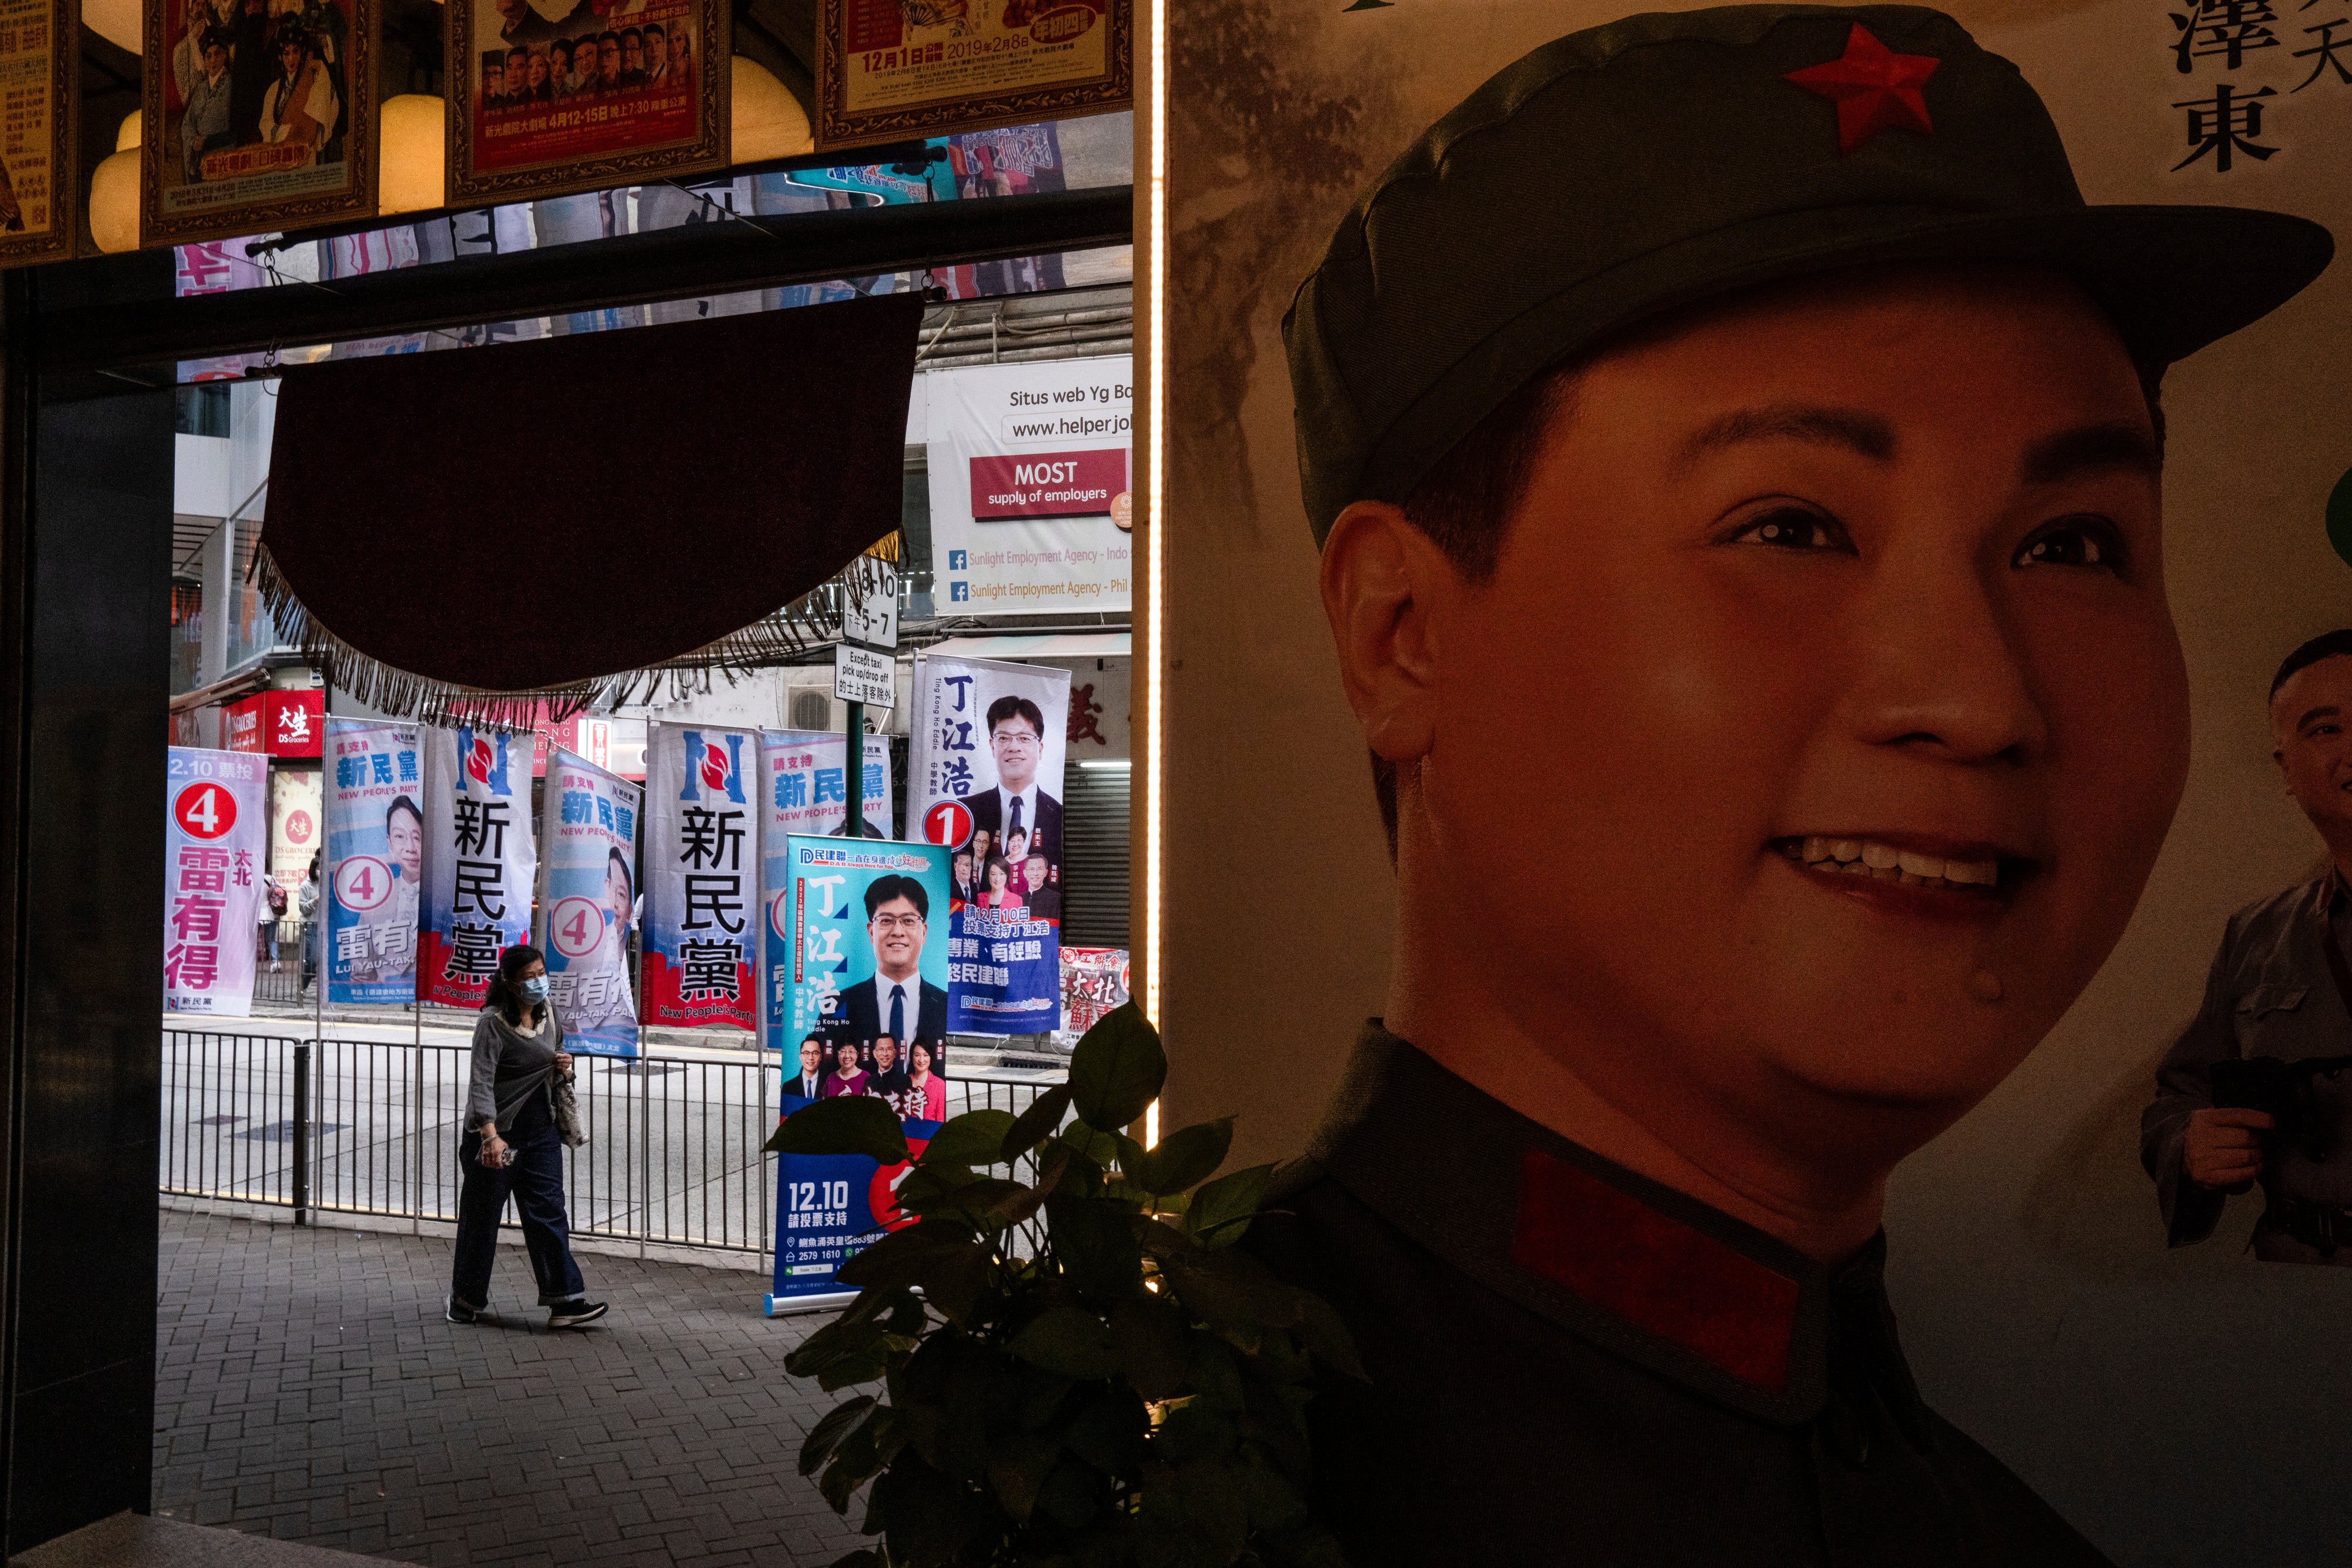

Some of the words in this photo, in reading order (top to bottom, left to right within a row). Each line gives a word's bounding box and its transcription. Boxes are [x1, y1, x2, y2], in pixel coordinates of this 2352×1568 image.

[947, 34, 1028, 59] 2019年2月8日
[862, 47, 923, 73] 12月1日
[2168, 0, 2281, 173] 澤東
[549, 105, 608, 129] 4月12-15日
[610, 99, 649, 118] 晚上7:30
[1009, 390, 1049, 407] Situs
[1053, 387, 1085, 403] web
[1090, 385, 1110, 403] Yg
[1012, 414, 1132, 437] www.helperjo
[1015, 461, 1078, 486] MOST
[988, 490, 1026, 506] supply
[1029, 489, 1041, 502] of
[1045, 487, 1107, 504] employers
[969, 551, 1004, 567] Sunlight
[1007, 549, 1062, 567] Employment
[1064, 547, 1097, 565] Agency
[1107, 547, 1128, 560] Indo
[971, 583, 1006, 600] Sunlight
[1009, 581, 1065, 599] Employment
[1067, 580, 1101, 597] Agency
[1111, 578, 1128, 593] Phil
[847, 613, 860, 631] 下午
[862, 608, 888, 635] 5-7
[850, 651, 870, 667] Except
[871, 657, 882, 669] taxi
[843, 664, 854, 677] pick
[856, 668, 878, 684] up/drop
[880, 673, 888, 684] off
[839, 679, 891, 702] 的士上落客除外
[279, 705, 310, 737] 大生
[934, 717, 940, 727] Ho
[279, 734, 288, 743] DS
[941, 675, 975, 796] 丁江浩
[337, 740, 368, 755] 請支持
[219, 762, 253, 780] 票投
[336, 749, 419, 790] 新民黨
[773, 754, 813, 771] 請支持
[563, 775, 594, 791] 請支持
[774, 763, 884, 810] 新民黨
[929, 762, 938, 795] 中學教師
[338, 791, 359, 801] NEW
[363, 788, 398, 797] PEOPLE'S
[400, 785, 418, 794] PARTY
[186, 789, 218, 832] 4
[561, 790, 634, 841] 新民黨
[776, 811, 801, 822] NEW
[804, 805, 847, 818] PEOPLE'S
[290, 818, 309, 837] 大生
[561, 827, 584, 837] NEW
[937, 807, 954, 845] 1
[815, 849, 847, 861] 民建聯
[232, 848, 253, 887] 太北
[349, 866, 375, 900] 4
[442, 796, 510, 985] 新民黨
[679, 805, 747, 1003] 新民黨
[964, 904, 1030, 923] 請12月10日
[165, 845, 229, 991] 雷有得
[562, 908, 585, 946] 4
[963, 920, 1050, 938] 投票支持丁江浩
[336, 919, 419, 962] 雷有
[807, 875, 846, 1015] 丁江浩
[335, 964, 355, 974] LUI
[1080, 953, 1121, 969] 工聯會
[1073, 971, 1115, 1004] 太北
[182, 997, 212, 1005] 新民黨
[794, 988, 804, 1029] 中學教師
[659, 1005, 683, 1019] New
[686, 1003, 731, 1020] People's
[731, 1007, 755, 1024] Party
[823, 1018, 839, 1027] Kong
[789, 1181, 848, 1212] 12.10
[788, 1212, 848, 1229] 請投票支持
[799, 1232, 890, 1248] 鰂魚涌英皇道883號
[799, 1251, 818, 1261] 2579
[821, 1249, 841, 1259] 1610
